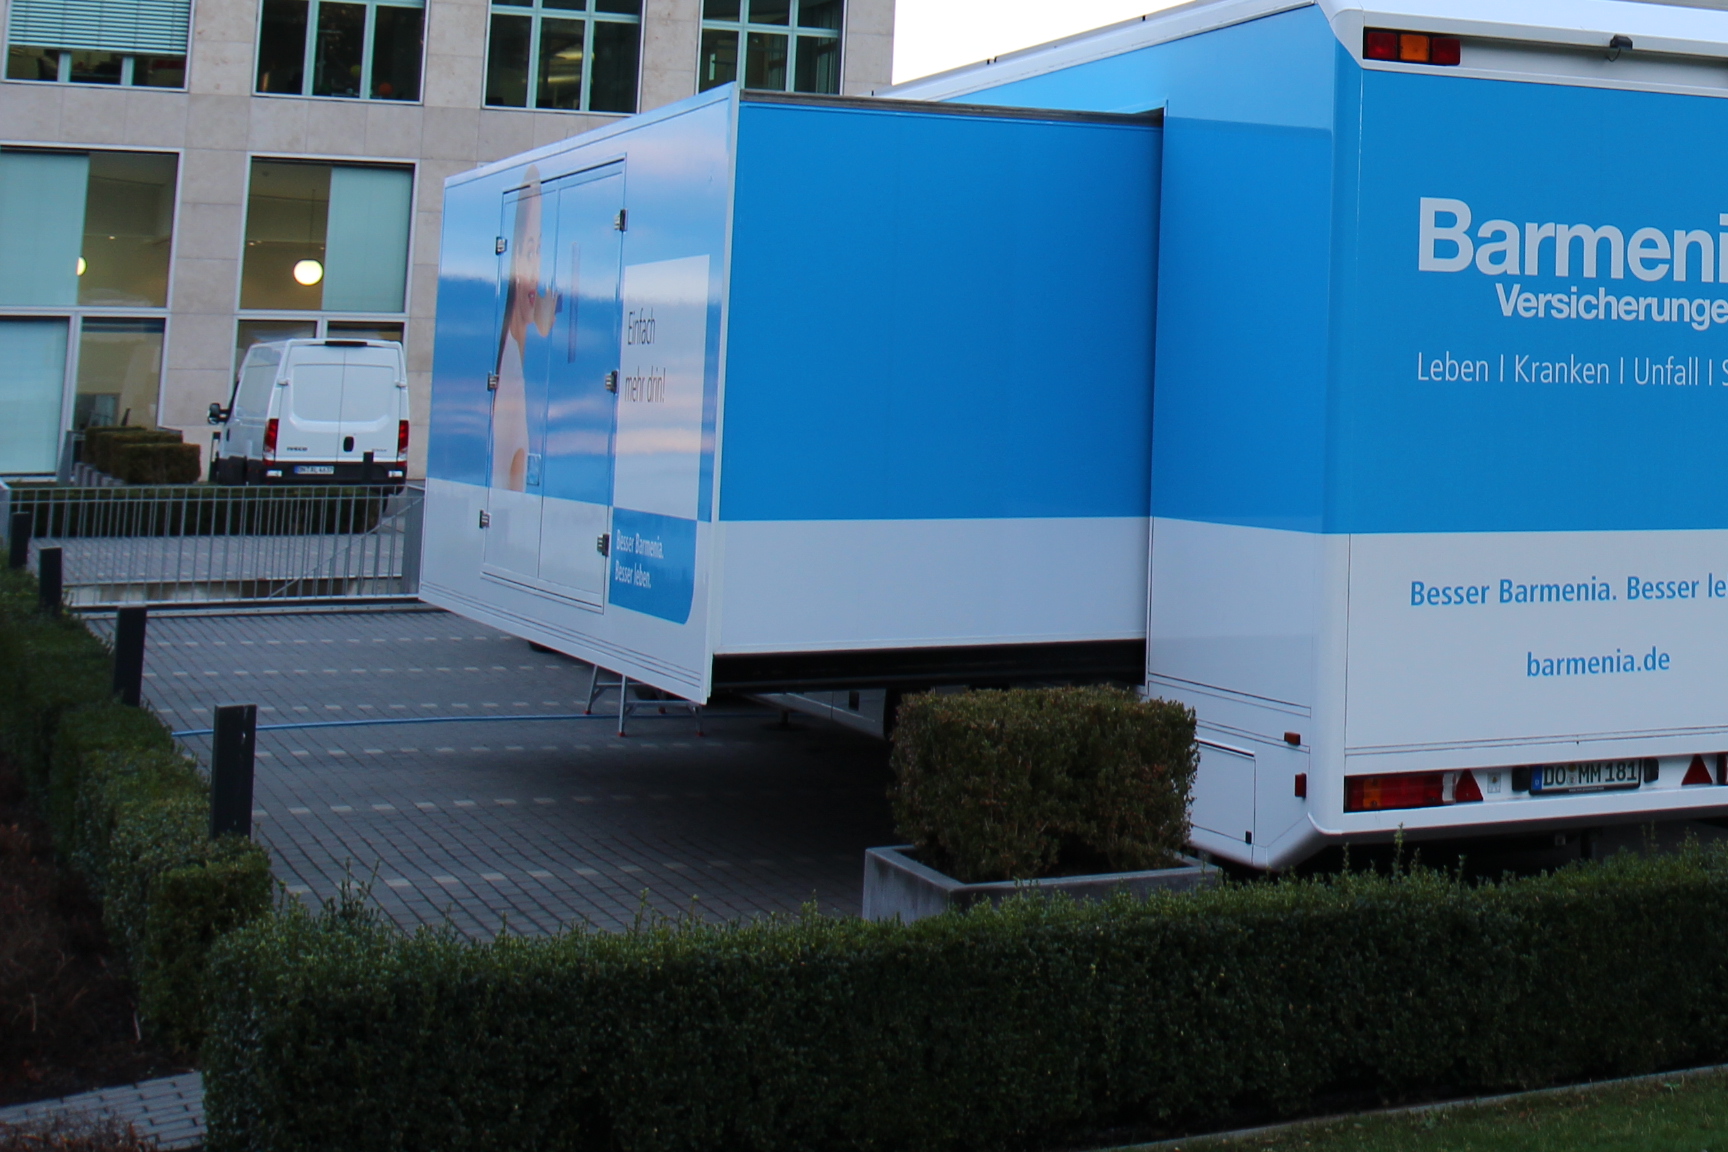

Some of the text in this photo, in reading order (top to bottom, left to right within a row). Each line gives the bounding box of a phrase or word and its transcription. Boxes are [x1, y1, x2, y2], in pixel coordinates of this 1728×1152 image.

[628, 308, 656, 345] Einfach
[1417, 350, 1489, 382] Leben
[1515, 353, 1610, 385] Kranken
[1634, 355, 1699, 386] Unfall
[625, 366, 666, 403] mehr drin!
[617, 529, 664, 559] Besser Barmenia.
[615, 559, 652, 588] Besser leben.
[1410, 581, 1490, 607] Besser
[1499, 575, 1617, 604] Barmenia.
[1627, 576, 1700, 601] Besser
[1526, 646, 1671, 677] barmenia.de
[1543, 760, 1638, 786] DO MM 181
